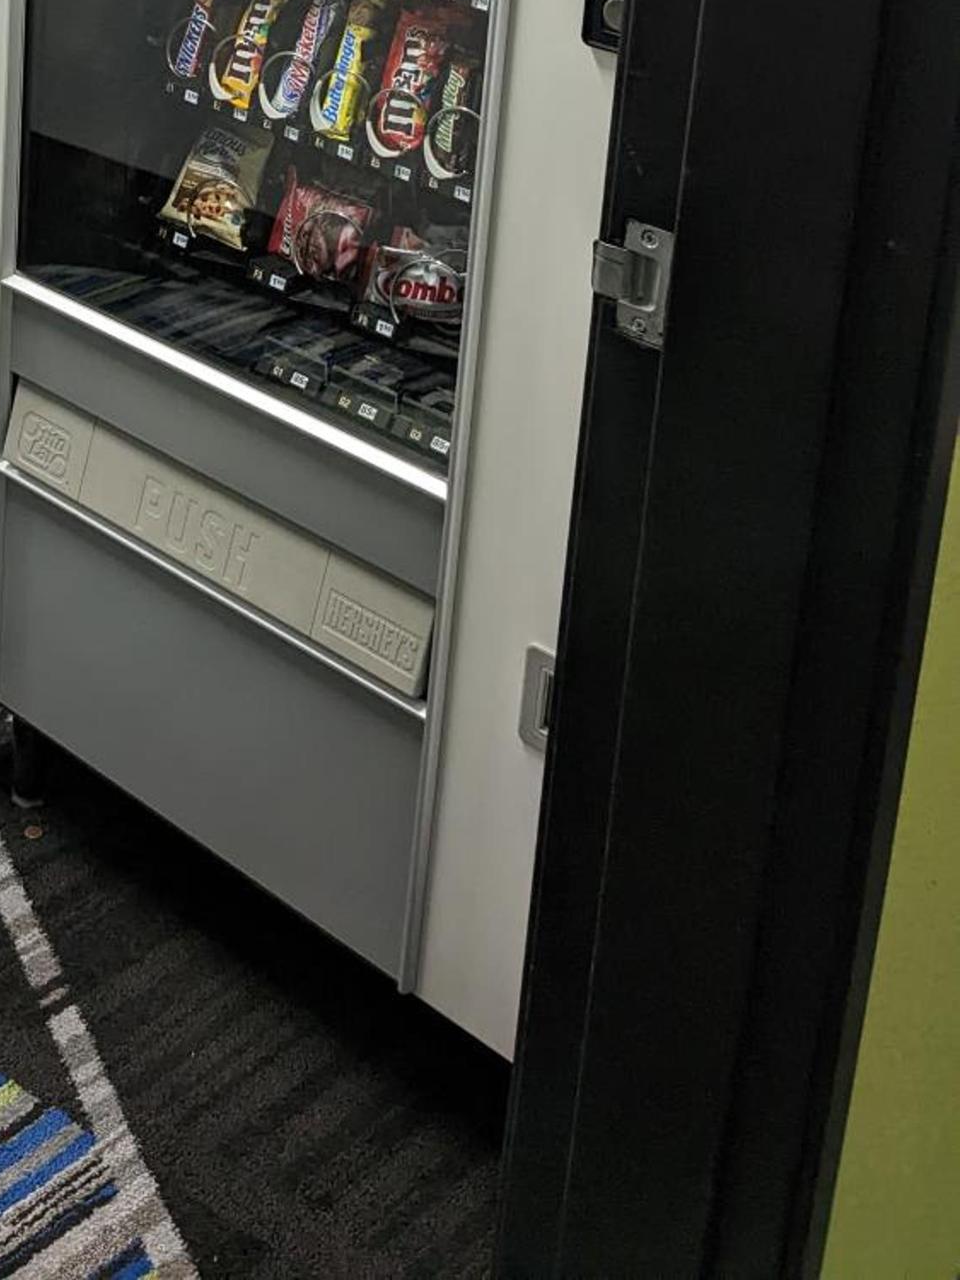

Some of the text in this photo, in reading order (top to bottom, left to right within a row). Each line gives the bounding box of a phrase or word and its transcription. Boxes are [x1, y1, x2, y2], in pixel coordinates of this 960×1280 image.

[174, 4, 208, 78] SNICKERS
[322, 30, 356, 125] Butterfinger
[134, 474, 261, 593] PUSH
